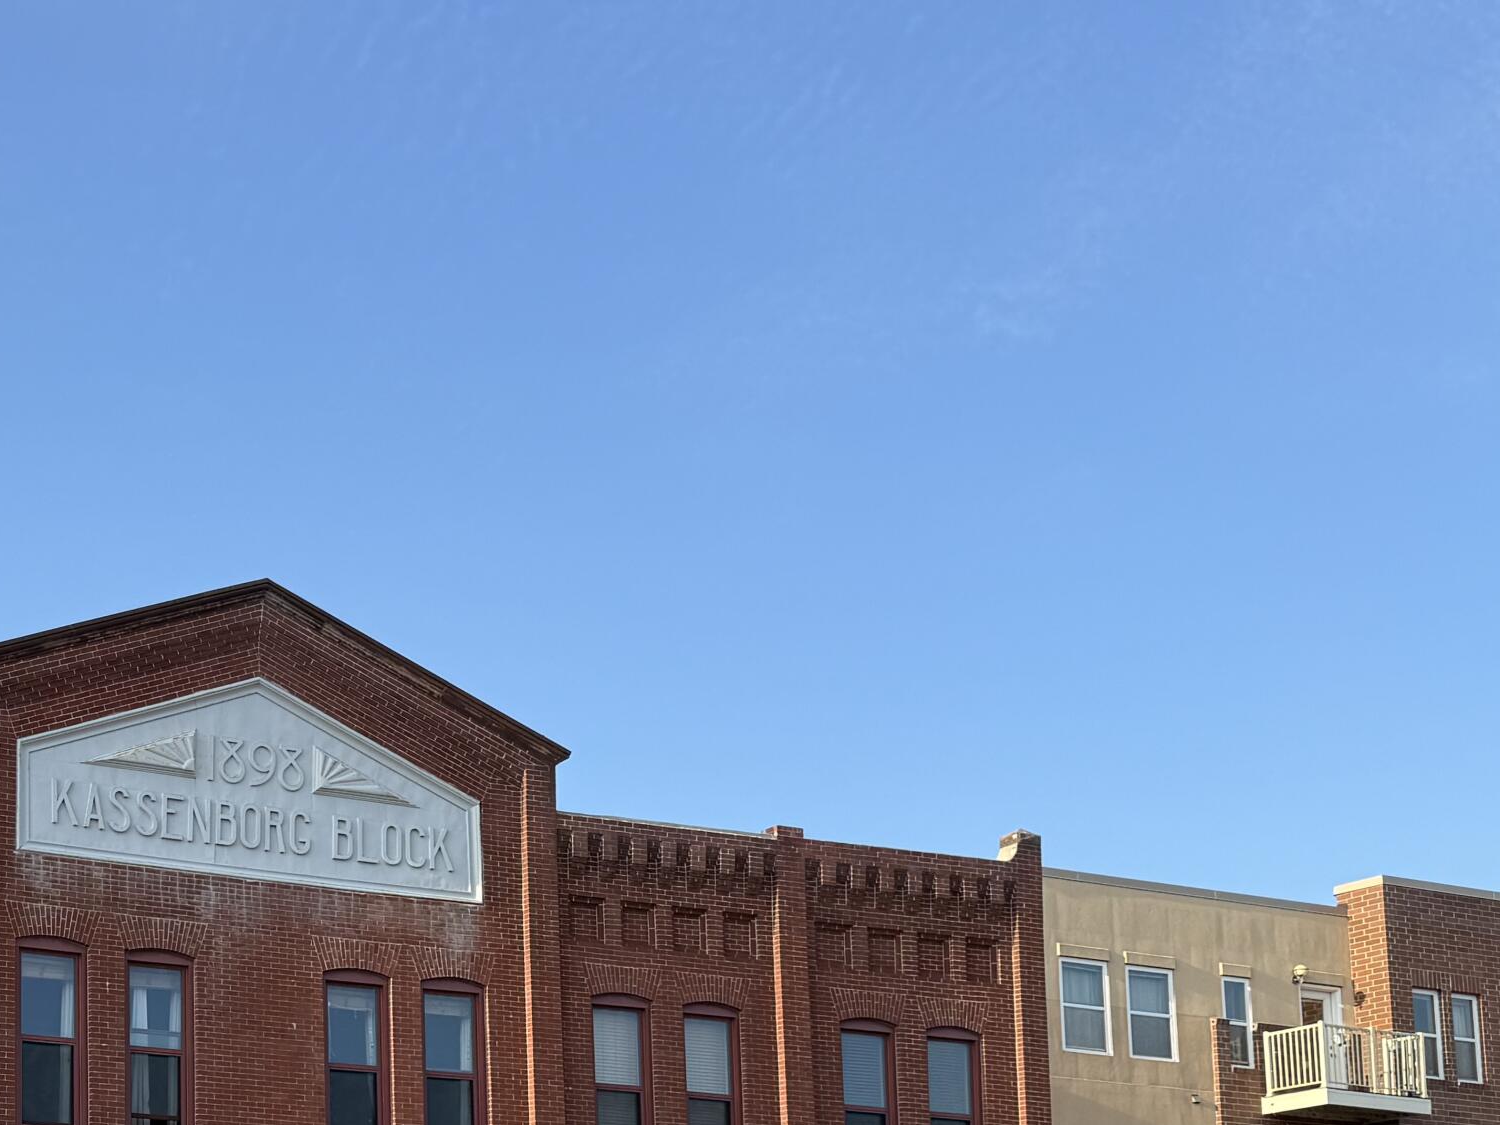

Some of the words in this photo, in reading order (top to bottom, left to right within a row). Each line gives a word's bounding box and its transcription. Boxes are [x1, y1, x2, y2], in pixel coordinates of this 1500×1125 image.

[207, 735, 305, 792] 1898
[51, 778, 312, 856] KASSENBORG
[332, 815, 454, 873] BLOCK
